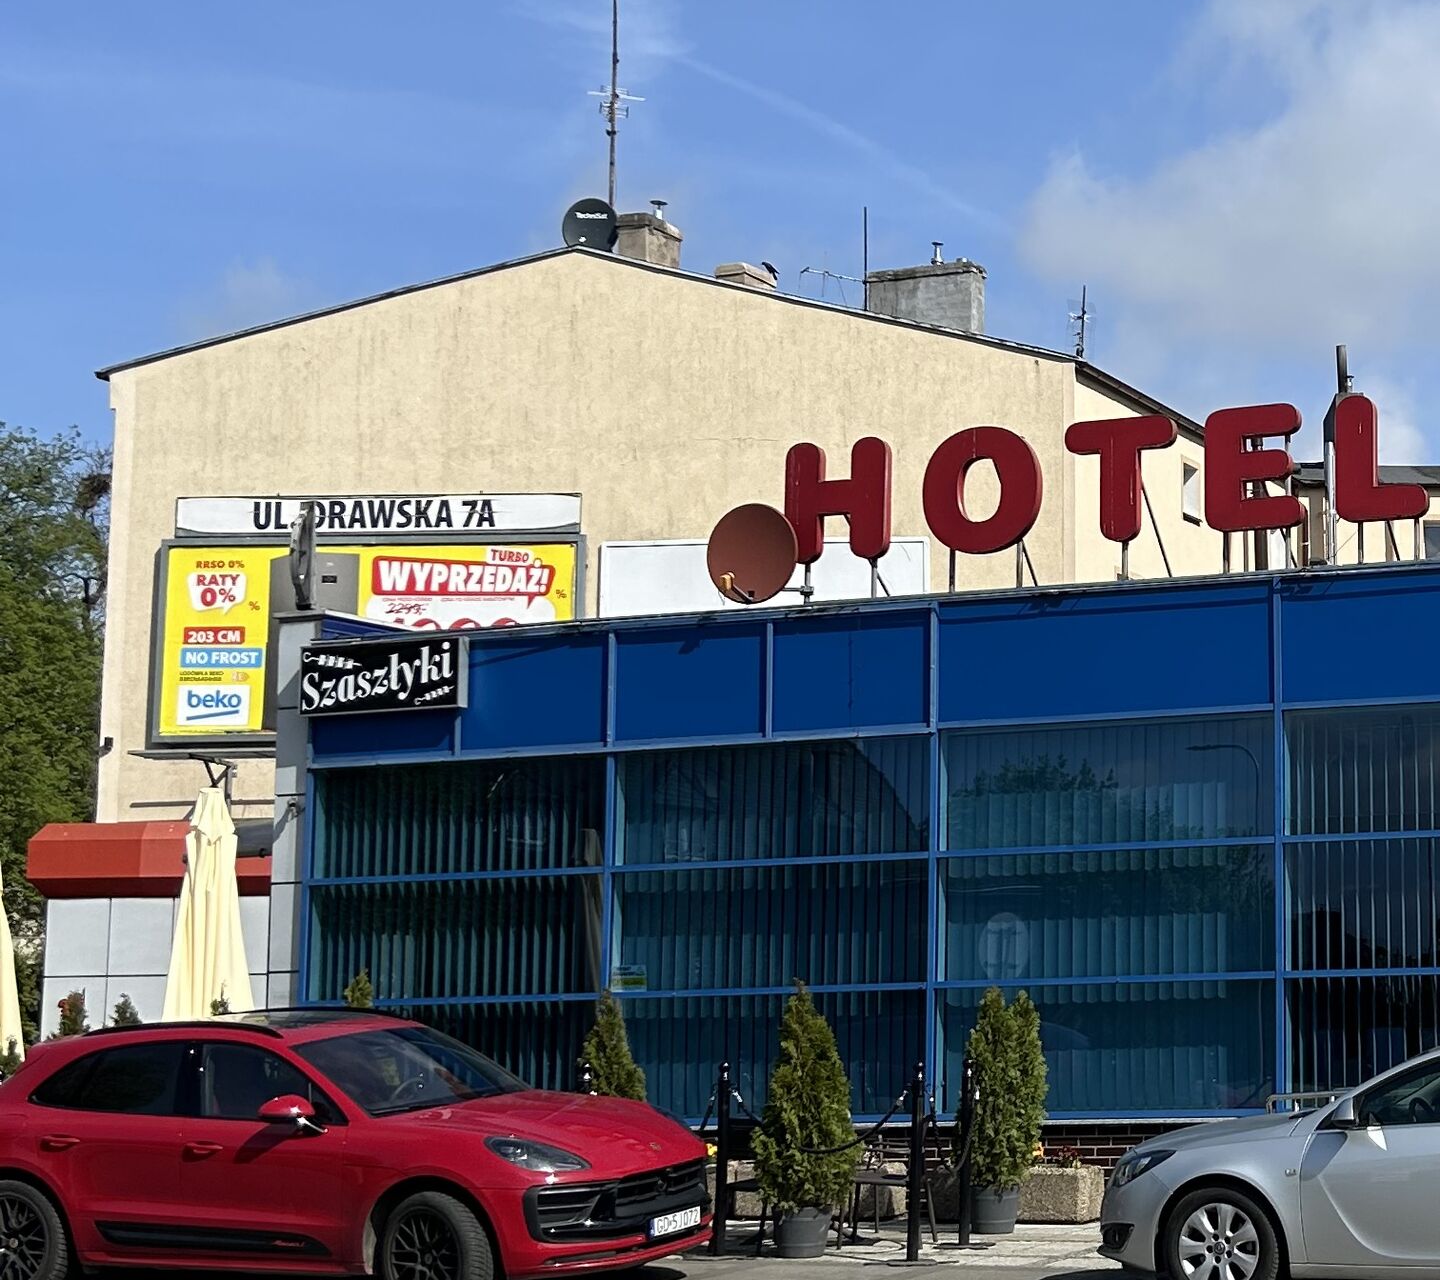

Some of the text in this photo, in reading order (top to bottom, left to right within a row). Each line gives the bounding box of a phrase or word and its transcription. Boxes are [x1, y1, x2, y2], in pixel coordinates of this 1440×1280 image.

[461, 499, 496, 529] 7A
[490, 548, 530, 564] TURBO
[196, 574, 240, 587] RATY
[378, 558, 550, 593] WYPRZEDAŻ!
[200, 588, 236, 607] 0%
[187, 630, 241, 643] 203 CM
[185, 651, 259, 664] NO FROST
[301, 641, 454, 711] Szaszłyki
[187, 690, 242, 708] beko
